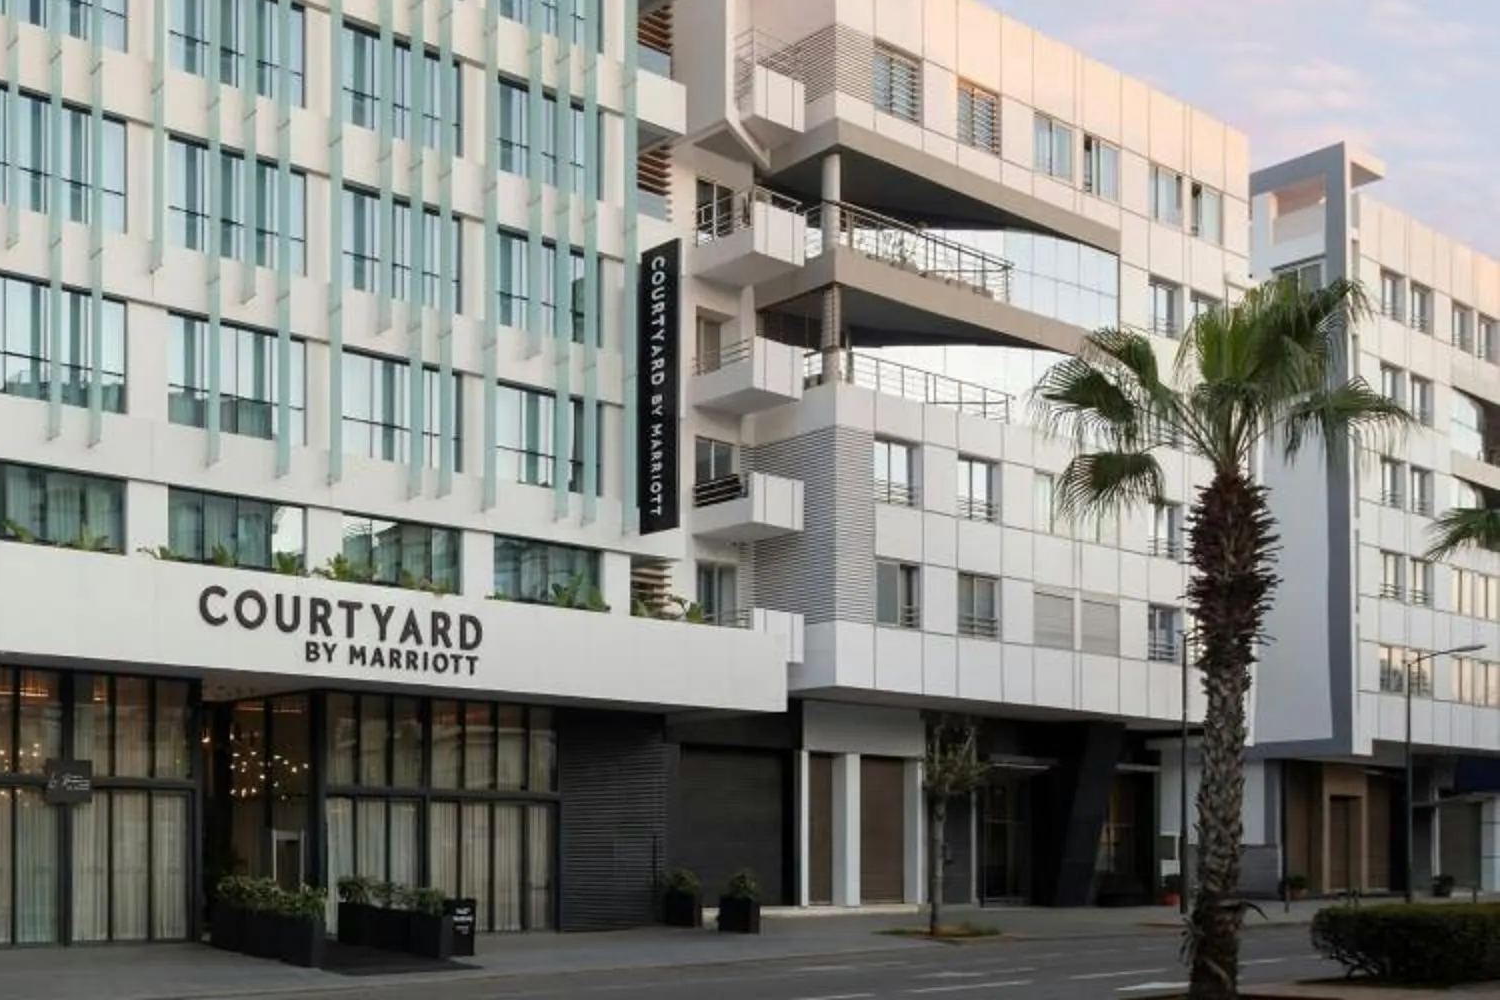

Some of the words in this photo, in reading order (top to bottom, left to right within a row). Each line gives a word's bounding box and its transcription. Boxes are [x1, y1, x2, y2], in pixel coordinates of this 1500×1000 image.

[651, 255, 666, 386] COURTYARD
[650, 393, 664, 417] BY
[649, 423, 664, 517] MARRIOTT
[199, 585, 484, 651] COURTYARD
[305, 640, 338, 663] BY
[349, 644, 479, 676] MARRIOTT
